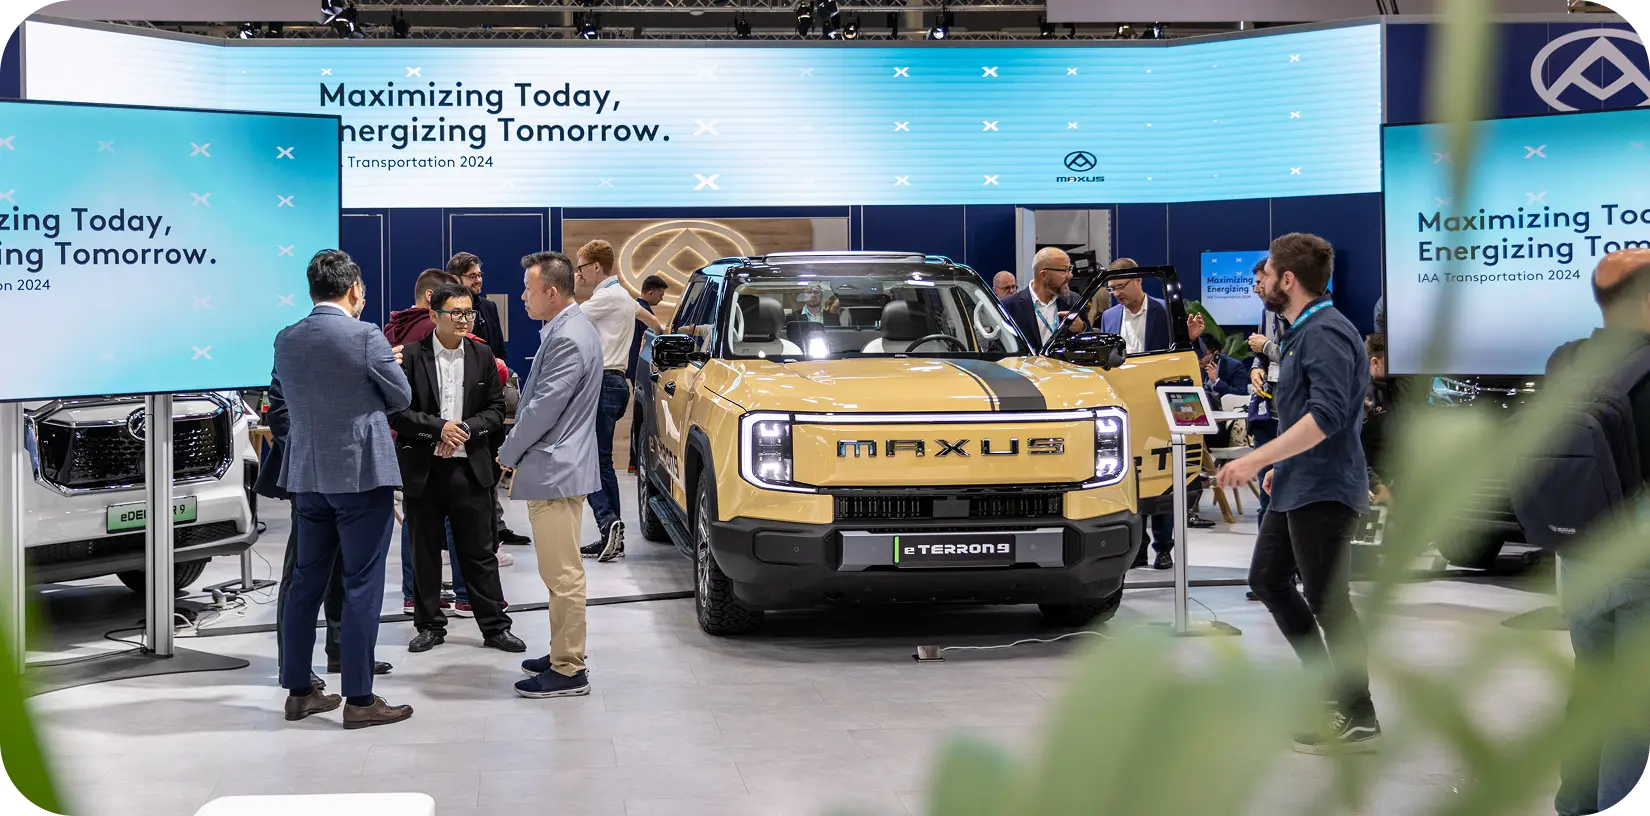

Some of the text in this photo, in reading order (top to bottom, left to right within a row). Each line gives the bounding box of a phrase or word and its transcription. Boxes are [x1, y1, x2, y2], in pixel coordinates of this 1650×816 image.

[320, 82, 620, 114] Maximizing Today,
[340, 117, 670, 150] nergizing Tomorrow.
[347, 156, 456, 171] Transportation
[460, 156, 494, 168] 2024
[71, 207, 172, 239] Today,
[1417, 205, 1590, 233] Maximizing
[54, 241, 217, 265] Tomorrow.
[1418, 236, 1573, 266] Energizing
[17, 278, 51, 291] 2024
[1206, 275, 1254, 285] Maximizing
[1417, 269, 1581, 285] IAA Transportation 2024
[1207, 285, 1249, 294] Energizing
[836, 437, 1065, 458] MAXUS
[180, 504, 185, 515] 9
